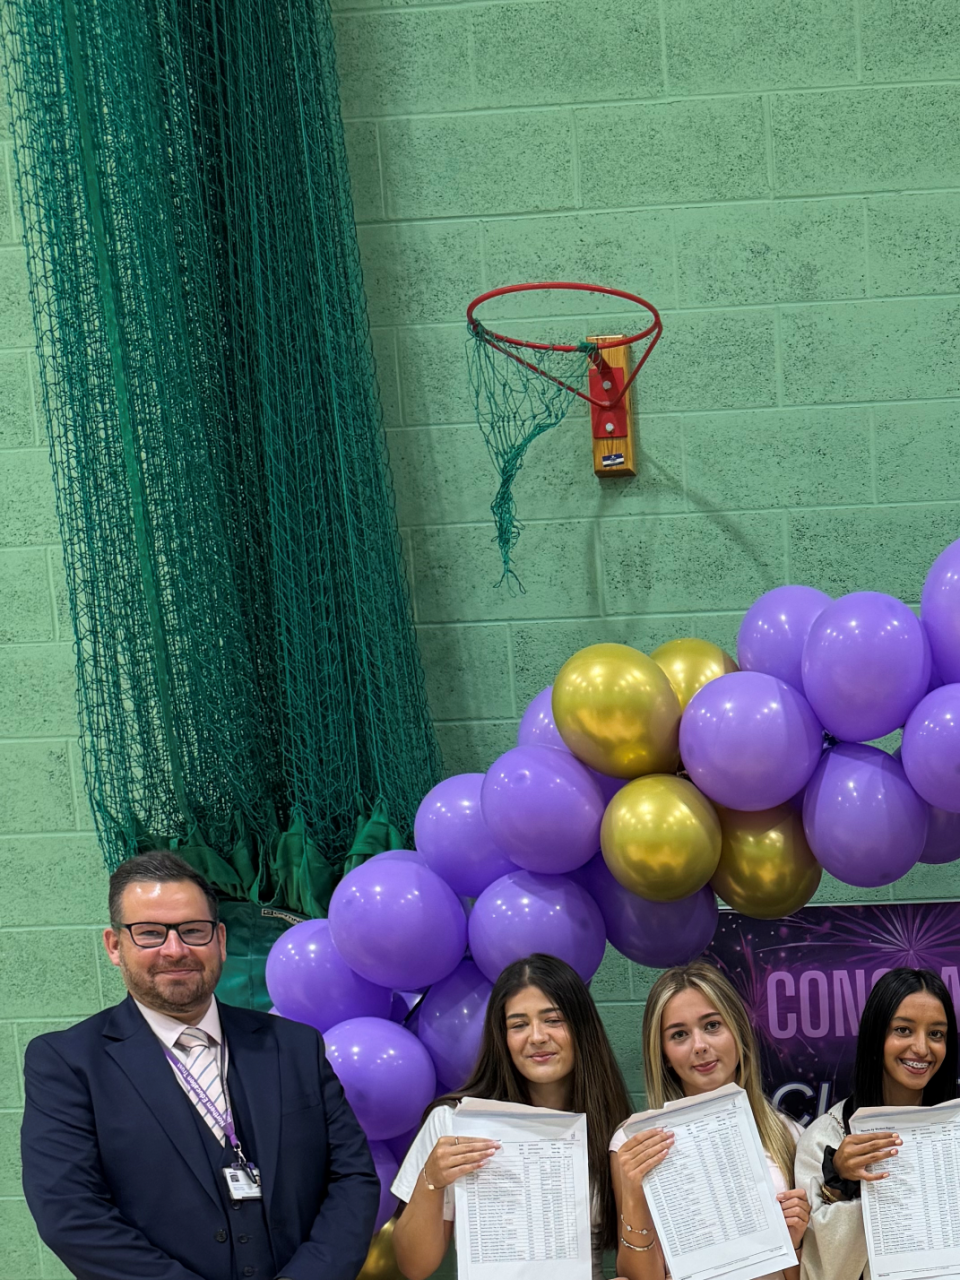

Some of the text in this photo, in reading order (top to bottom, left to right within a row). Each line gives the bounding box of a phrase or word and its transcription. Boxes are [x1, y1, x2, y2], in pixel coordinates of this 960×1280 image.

[177, 1062, 226, 1127] Northern Education Trust
